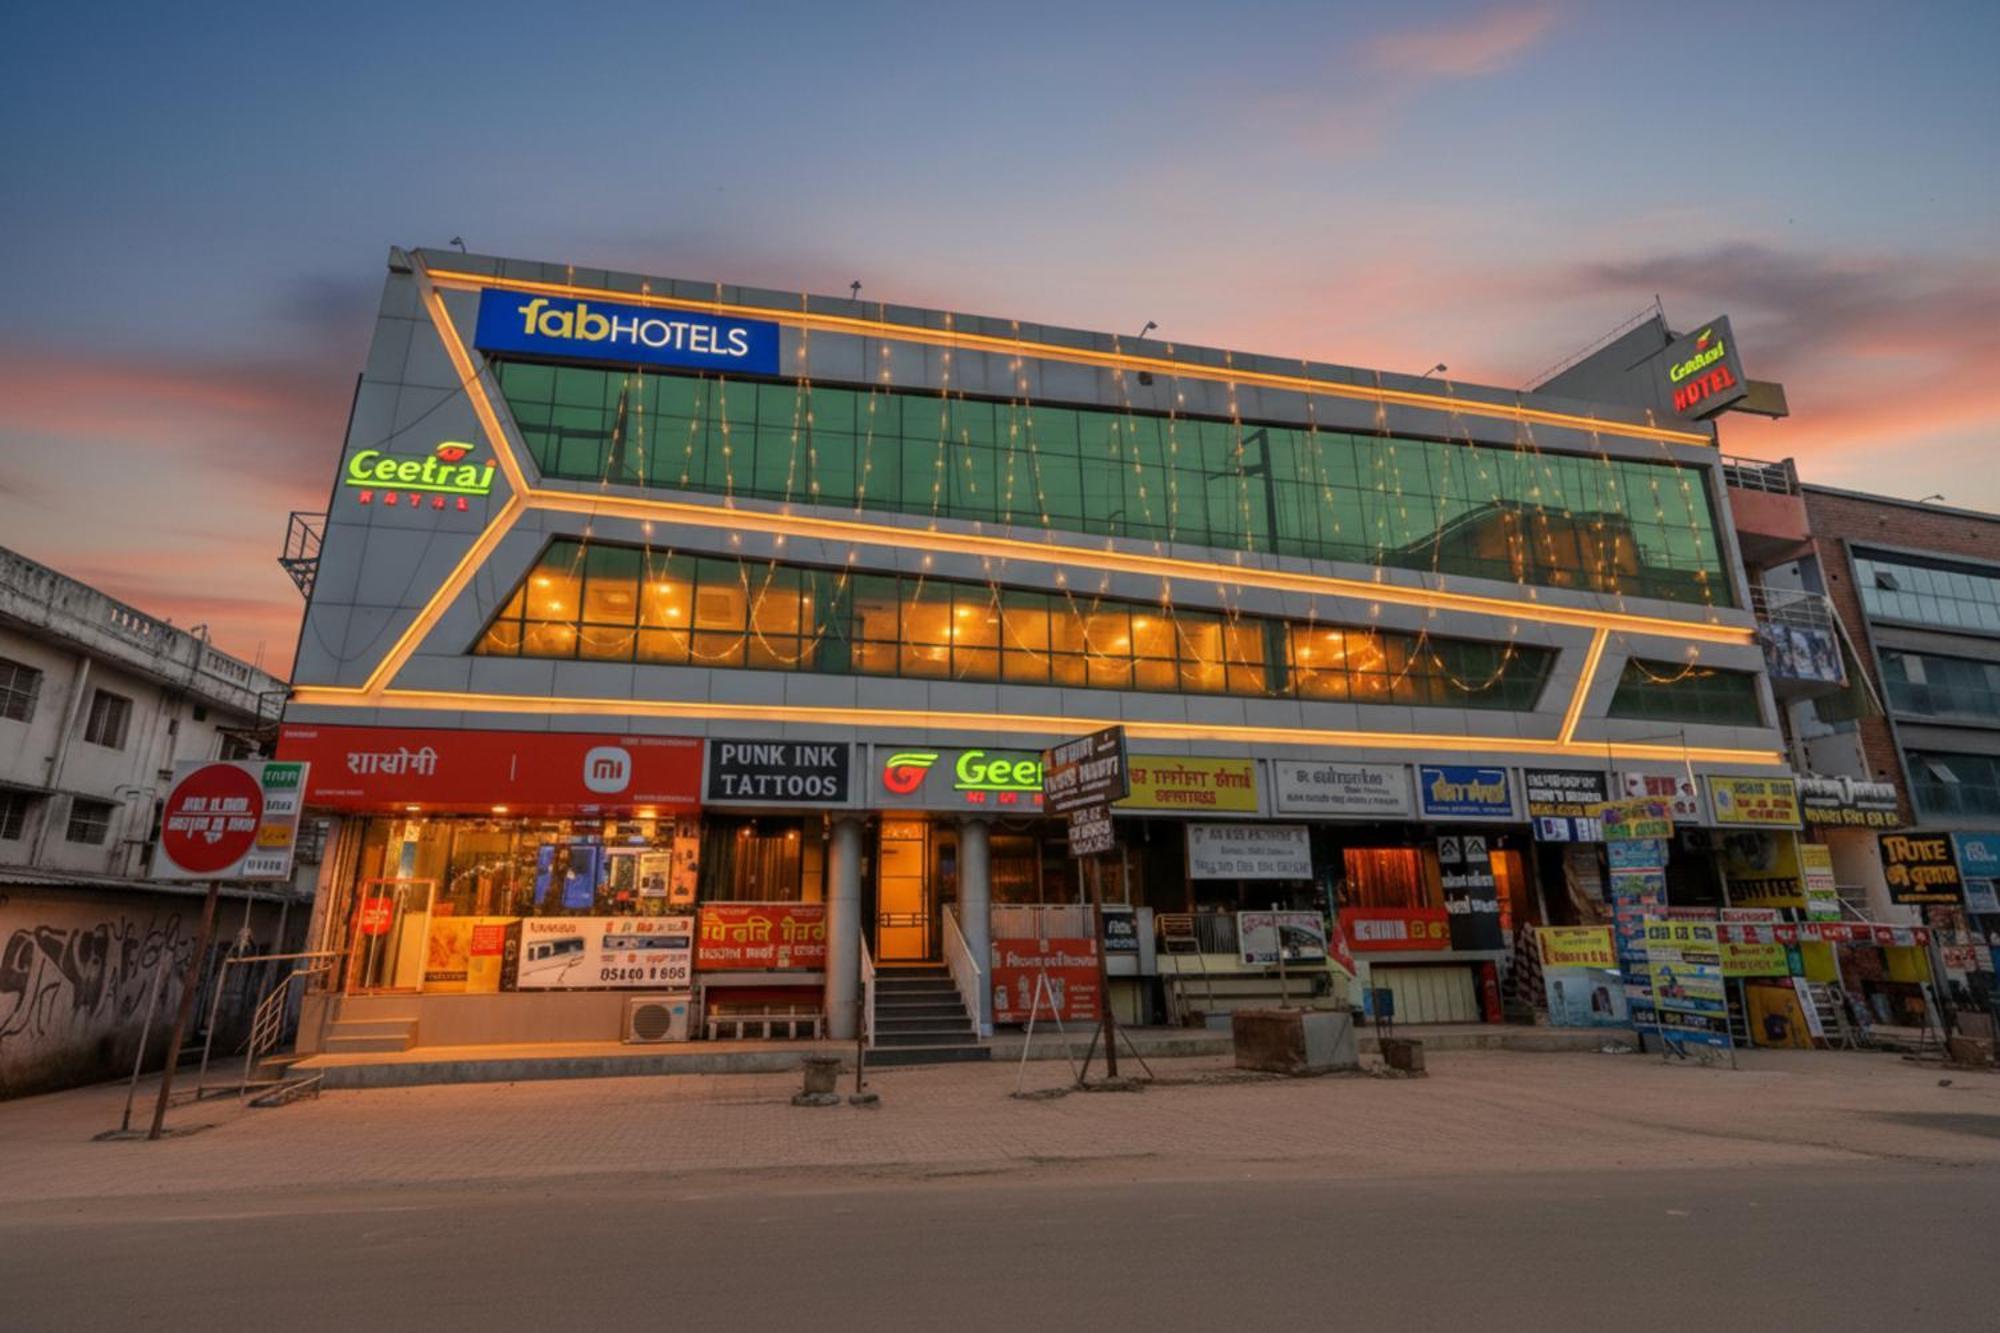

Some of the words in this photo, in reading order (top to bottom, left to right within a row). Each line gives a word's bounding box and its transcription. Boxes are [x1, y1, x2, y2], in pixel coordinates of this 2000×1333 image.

[721, 744, 786, 766] PUNK
[795, 746, 838, 767] INK
[721, 774, 838, 796] TATTOOS
